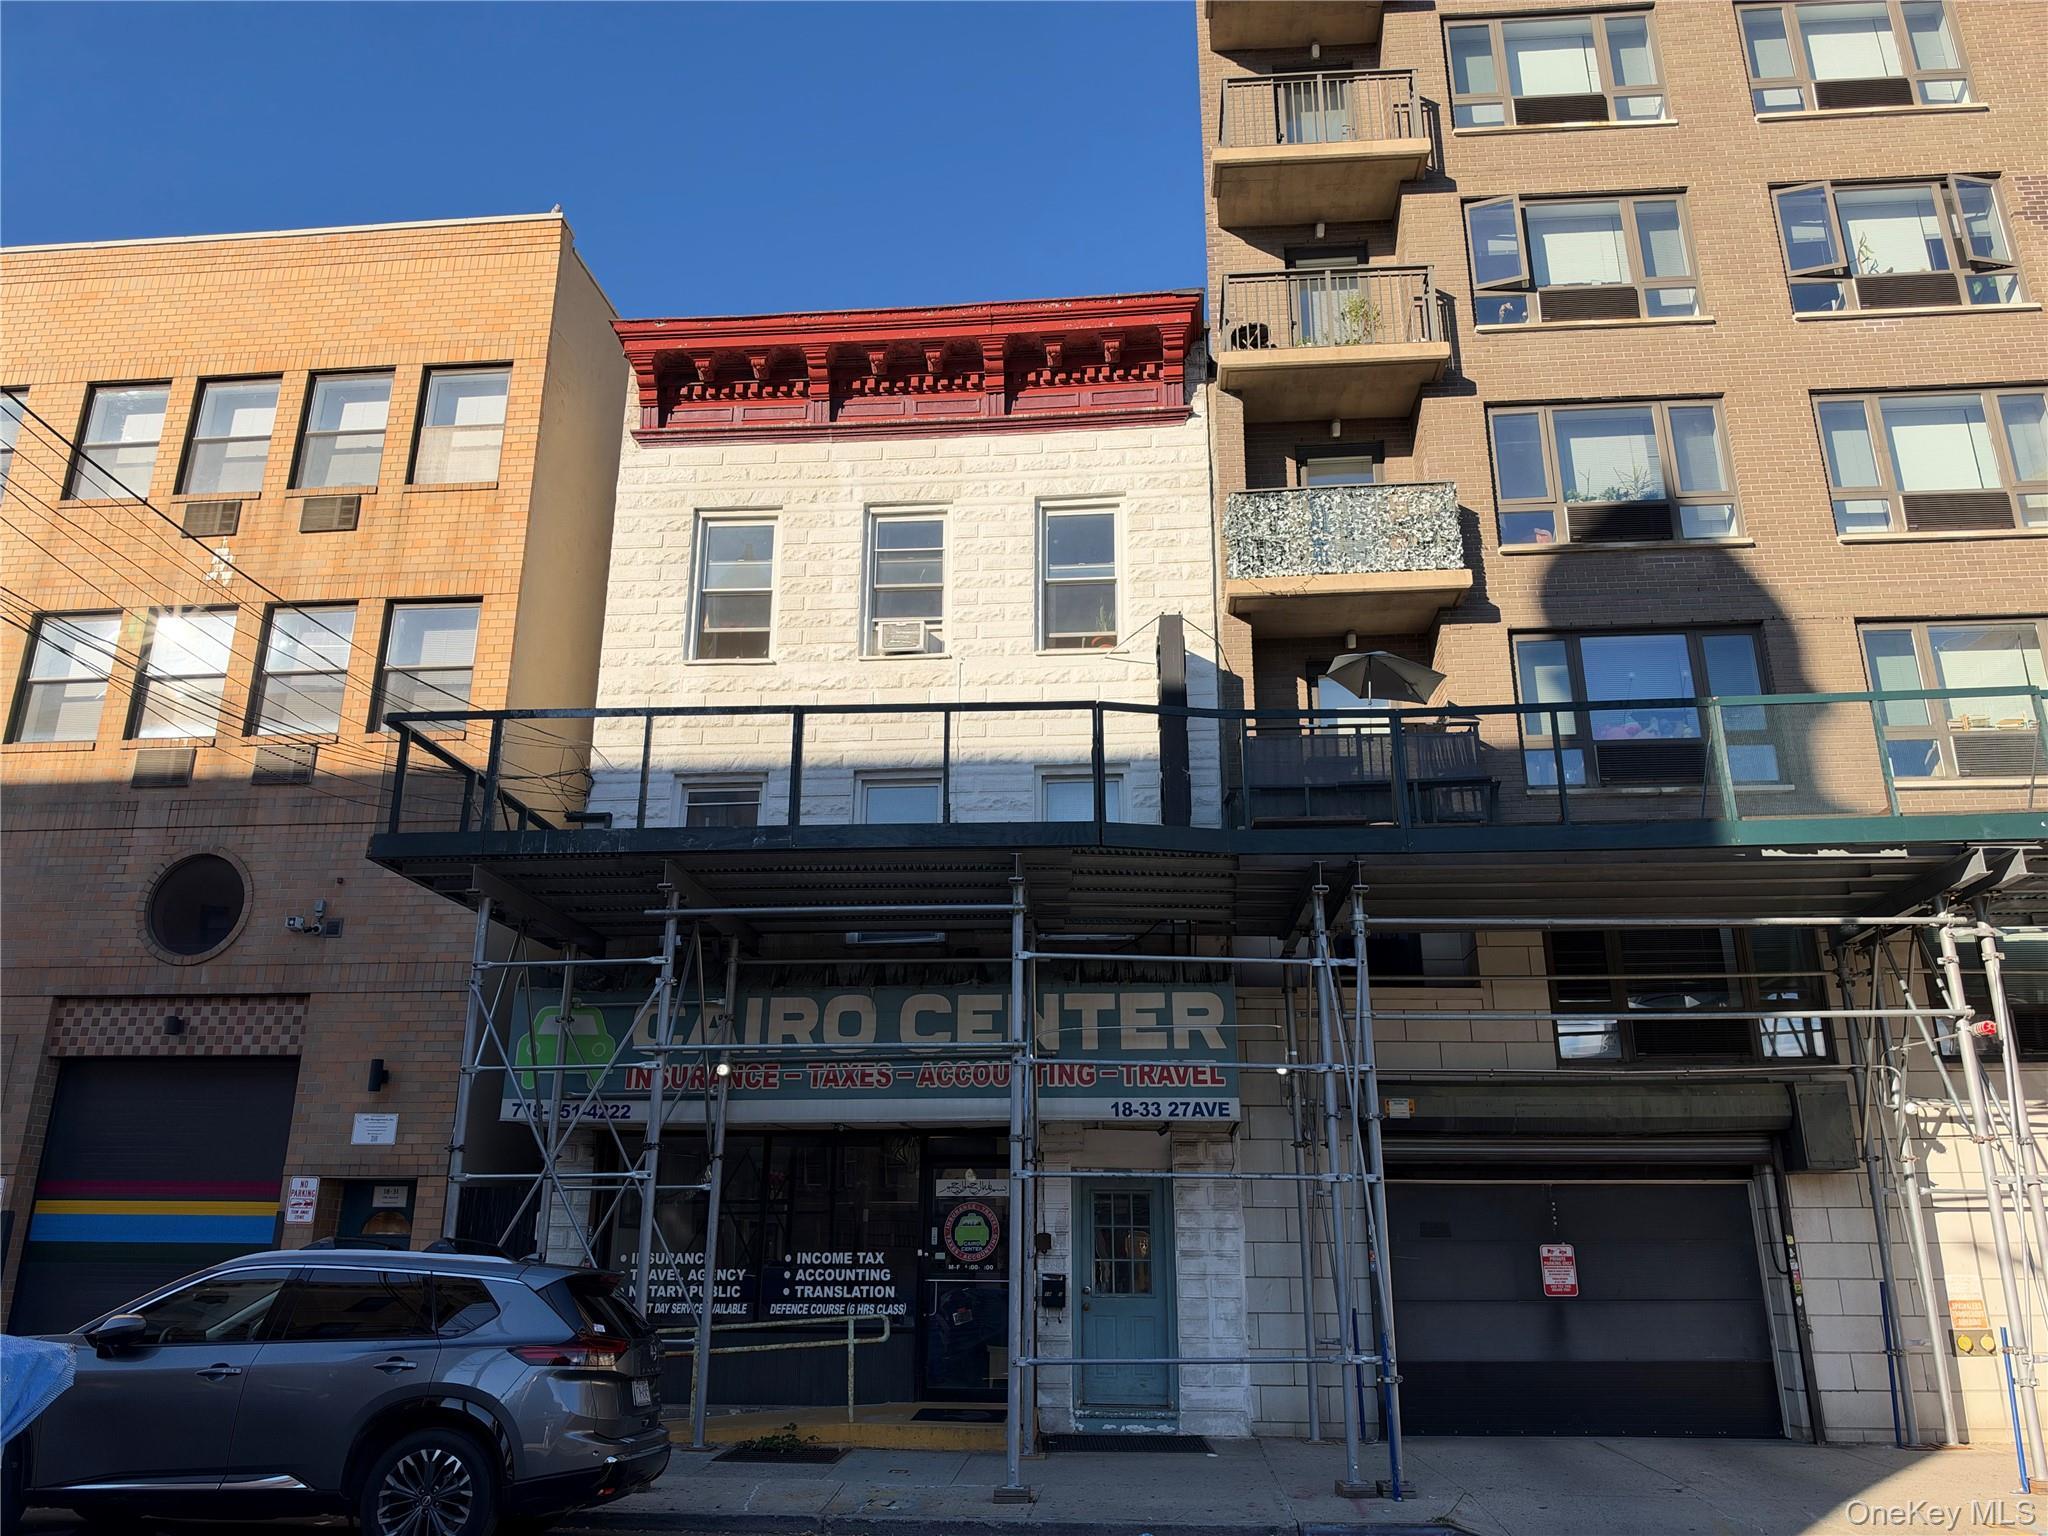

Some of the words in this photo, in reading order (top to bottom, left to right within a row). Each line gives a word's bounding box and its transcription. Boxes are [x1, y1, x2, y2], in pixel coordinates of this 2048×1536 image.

[632, 994, 877, 1056] CAIRO
[899, 991, 1228, 1053] CENTER
[806, 1062, 893, 1090] TAXES
[916, 1060, 1098, 1089] ACCOUTING
[1119, 1061, 1226, 1088] TRAVEL
[1111, 1101, 1162, 1117] 18-33
[1168, 1101, 1231, 1117] 27AVE
[300, 1180, 309, 1188] NO
[290, 1189, 316, 1197] PARKING
[797, 1252, 853, 1265] INCOME
[857, 1252, 885, 1264] TAX
[795, 1268, 891, 1281] ACCOUNTING
[628, 1285, 684, 1297] NTARY
[794, 1286, 896, 1298] TRANSLATION
[654, 1303, 671, 1314] DAY
[769, 1303, 809, 1315] DEFENCE
[810, 1303, 846, 1315] COURSE
[857, 1303, 875, 1314] HRS
[876, 1302, 907, 1315] CLASS)
